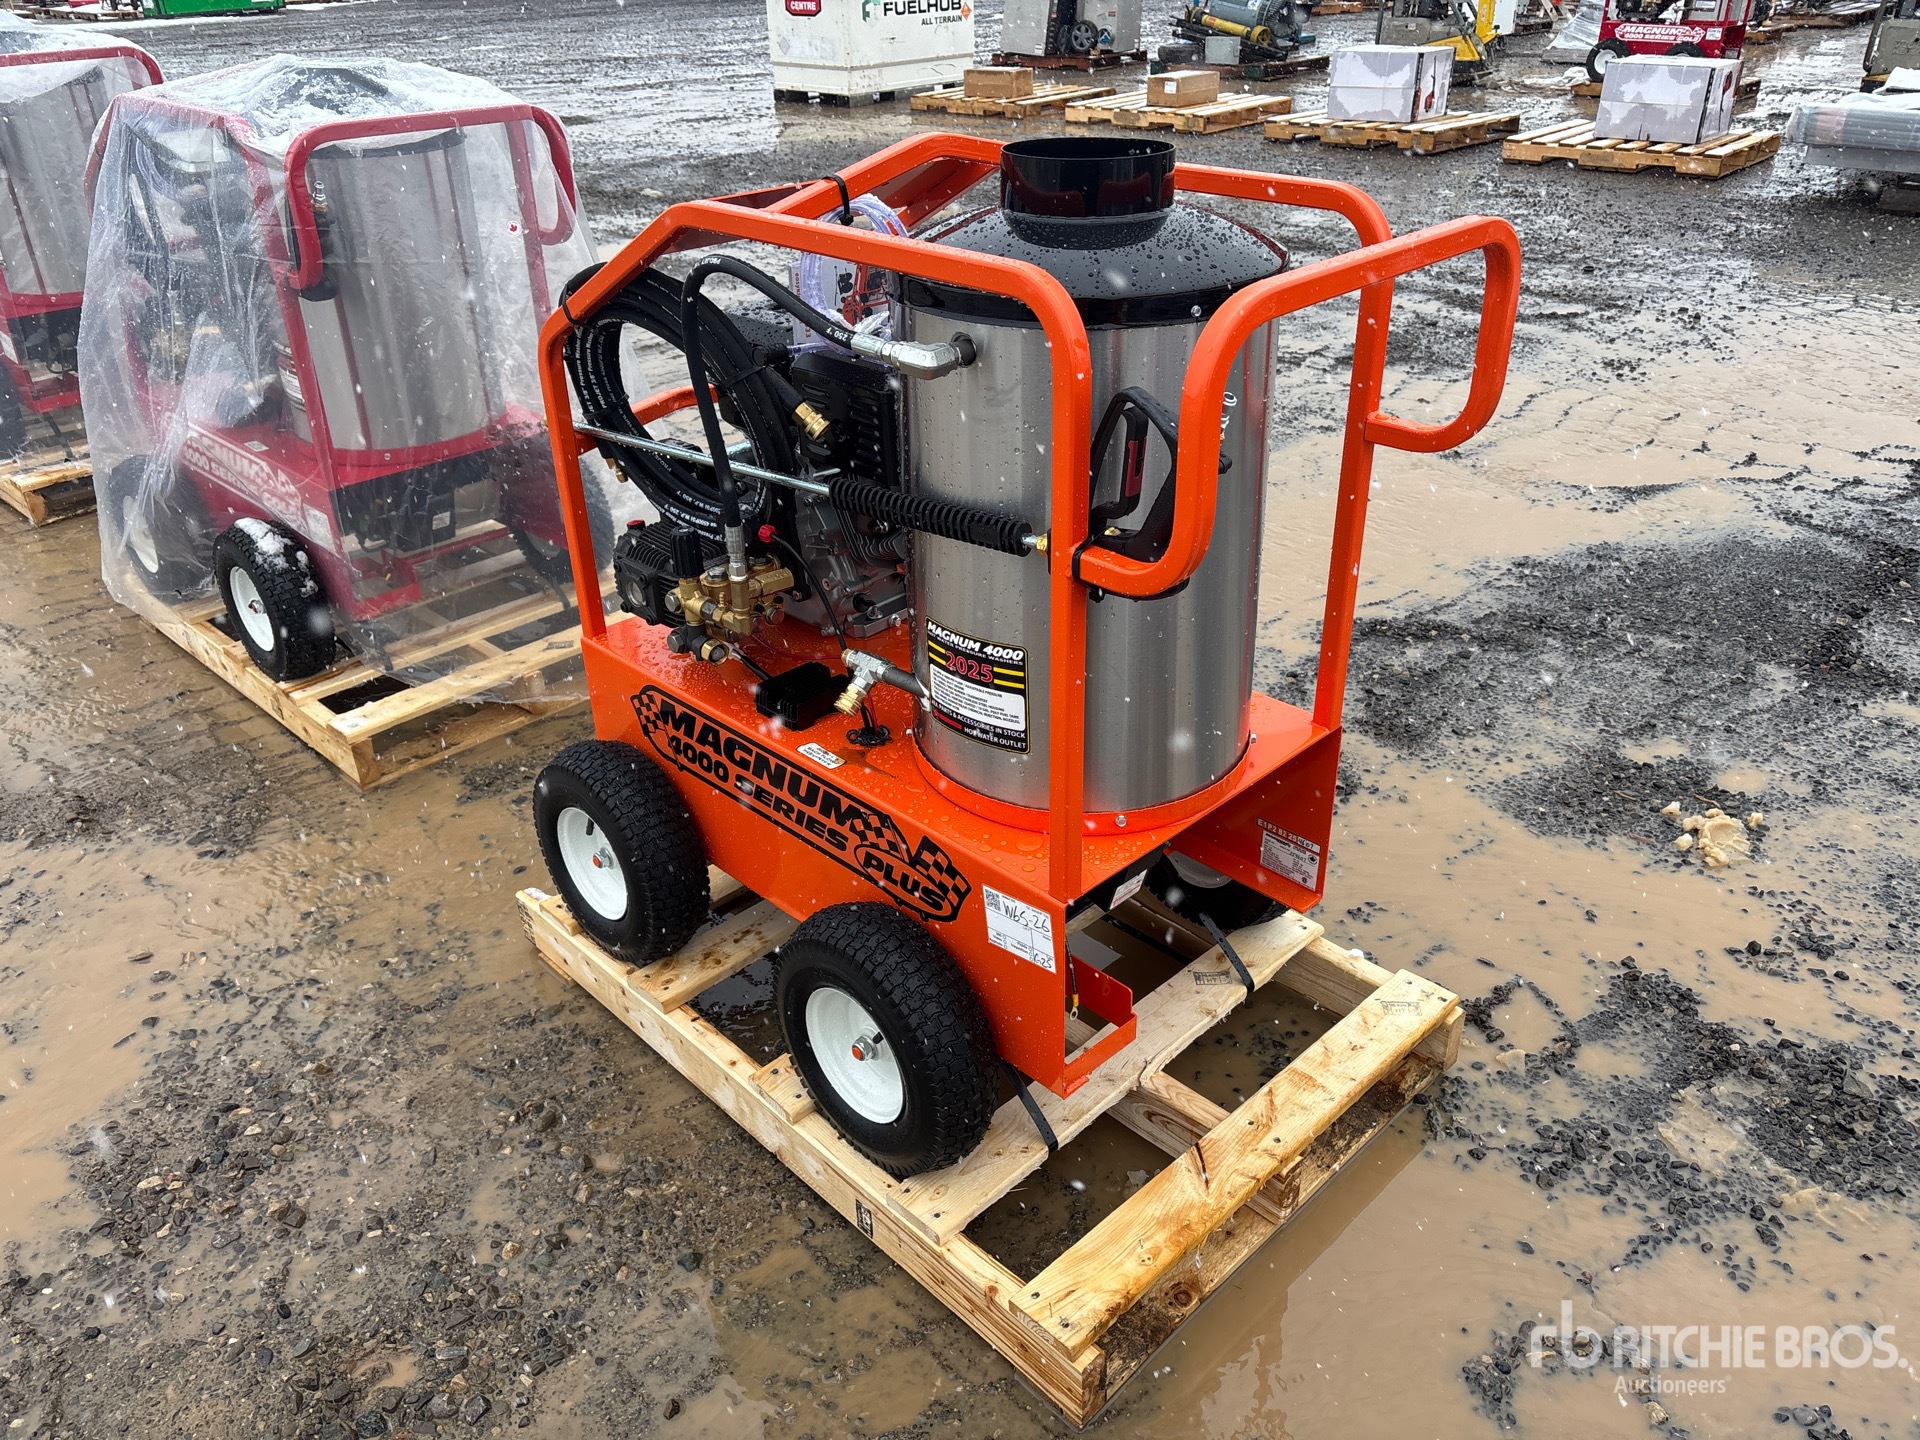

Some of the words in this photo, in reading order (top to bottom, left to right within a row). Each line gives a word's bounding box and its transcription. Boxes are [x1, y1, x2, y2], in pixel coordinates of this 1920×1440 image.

[790, 1, 817, 11] CENTRE
[883, 0, 962, 17] FUELHUB
[921, 17, 934, 26] ALL
[935, 14, 963, 25] TERRAIN
[1622, 26, 1681, 35] MAGNUM
[834, 329, 847, 342] 250
[576, 359, 586, 387] Pressure
[593, 385, 608, 409] PROJET
[211, 461, 259, 496] SERIES
[670, 506, 679, 515] 250
[682, 493, 692, 503] 250
[928, 621, 982, 652] MAGNUM
[983, 645, 1024, 661] 4000
[937, 636, 954, 648] WATER
[955, 646, 986, 659] PRESSURE
[988, 655, 1024, 666] WASHERS
[945, 650, 994, 683] 2025
[938, 703, 953, 716] PARTS
[957, 714, 994, 732] ACCESSORIES
[1003, 729, 1026, 739] STOCK
[977, 732, 999, 743] WATER
[999, 738, 1026, 749] OUTLET
[658, 699, 868, 833] MAGNUM
[668, 734, 730, 783] 4000
[733, 772, 850, 853] SERIES
[862, 854, 947, 912] PLUS
